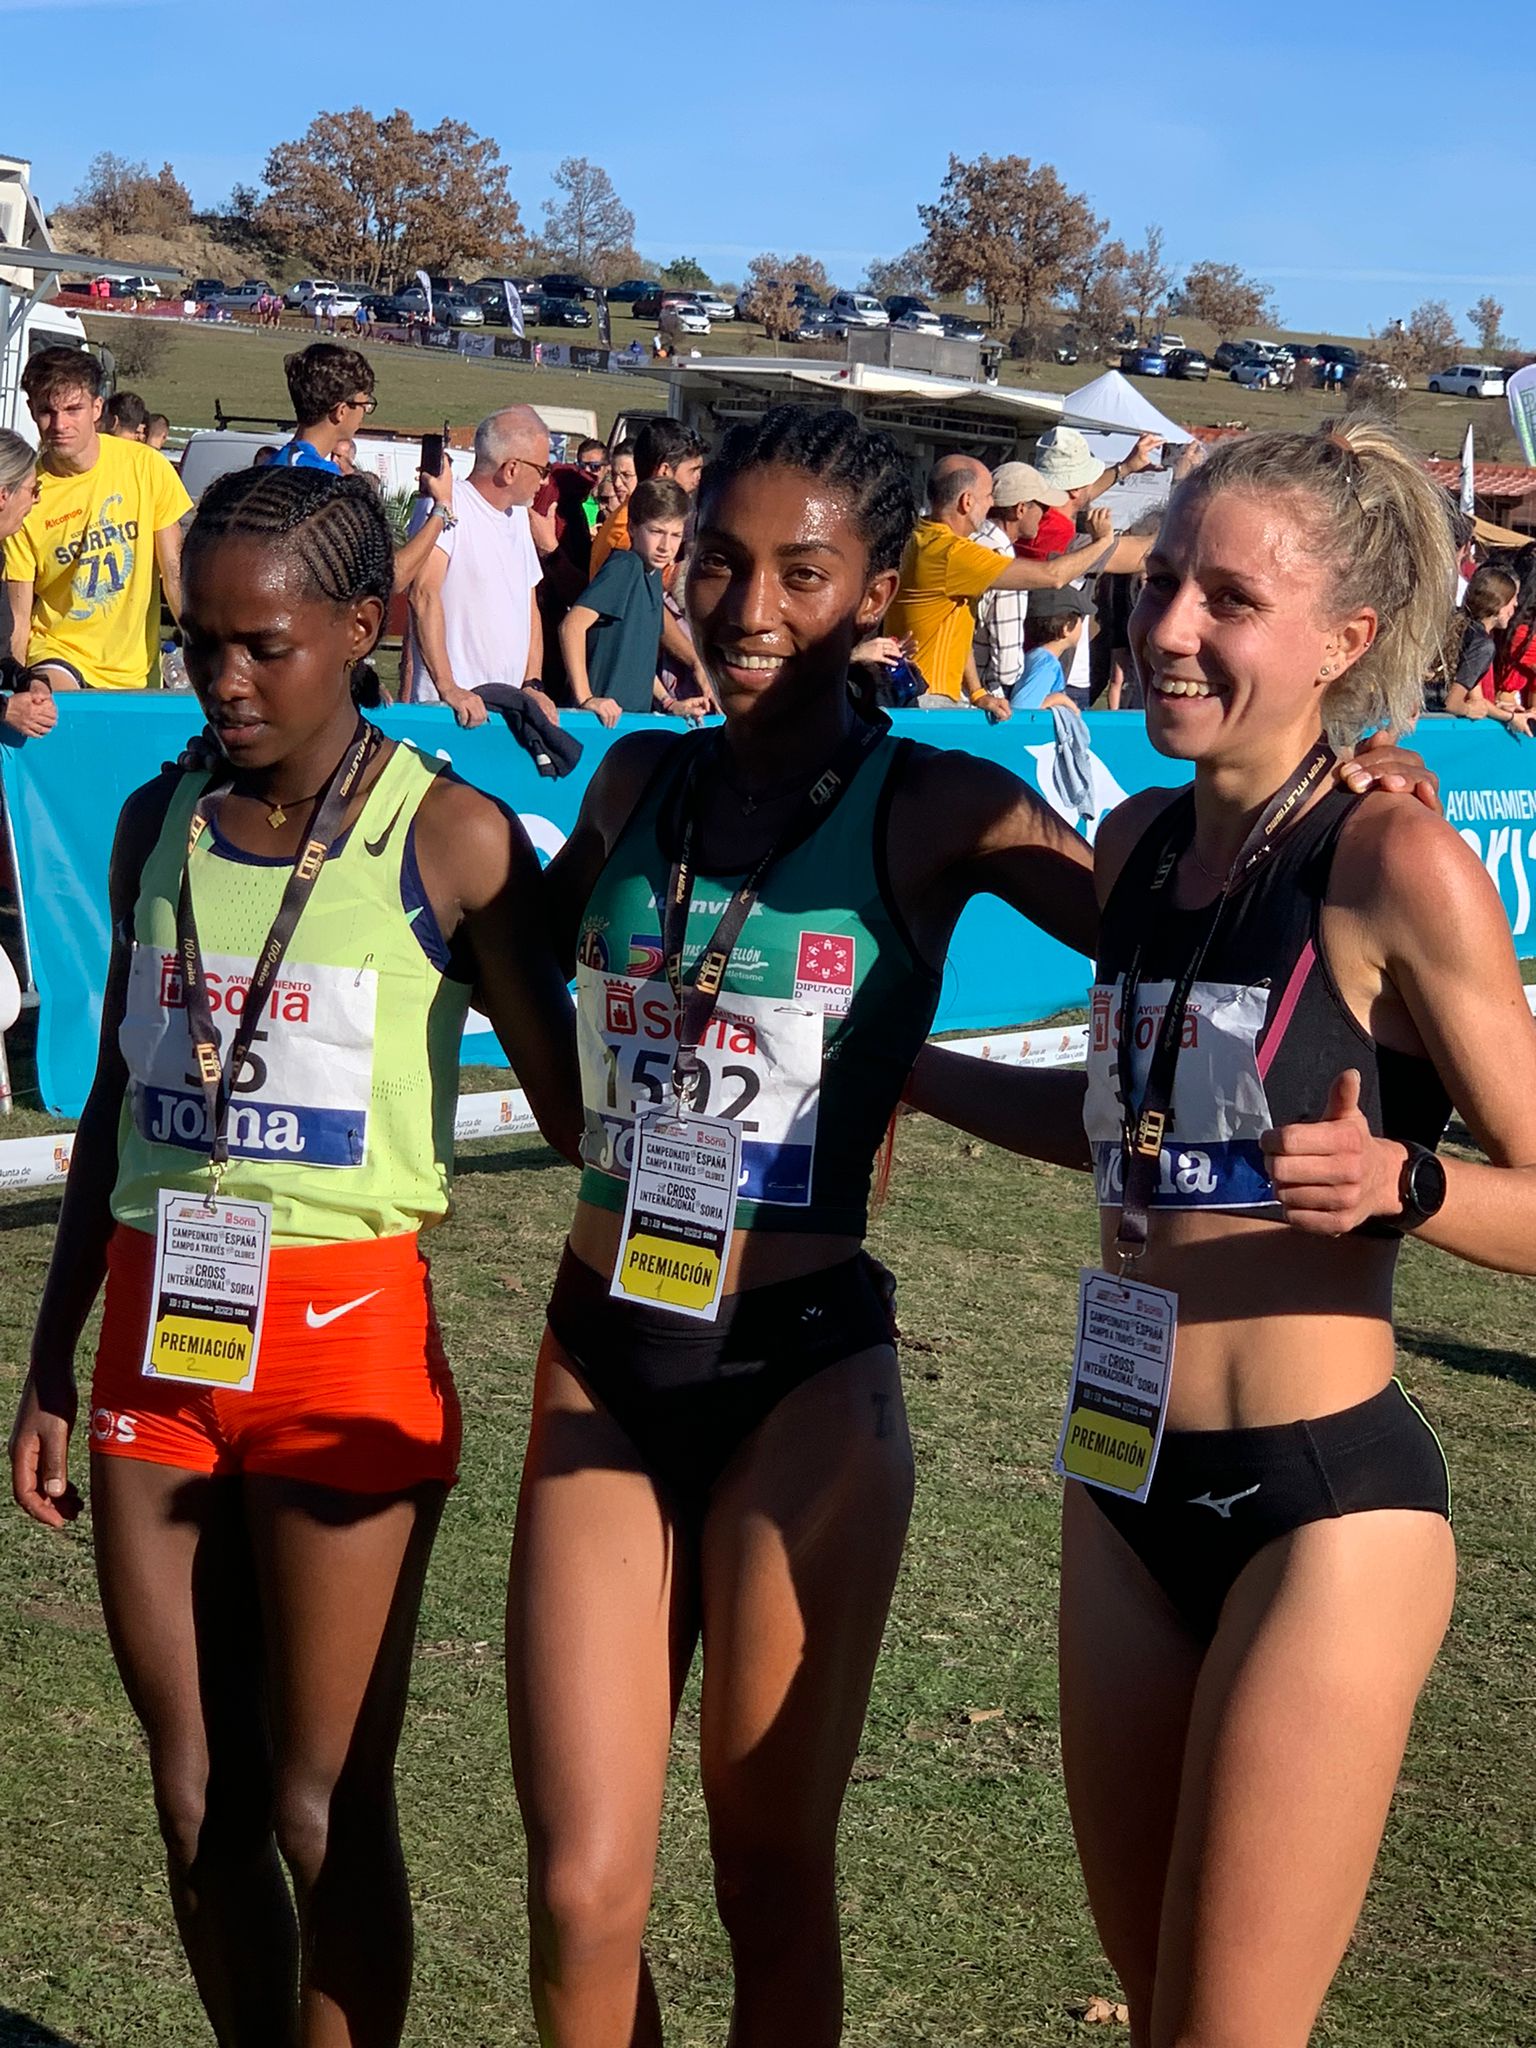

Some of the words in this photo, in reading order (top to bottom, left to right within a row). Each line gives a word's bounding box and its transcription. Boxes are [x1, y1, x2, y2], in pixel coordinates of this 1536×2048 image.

[78, 551, 125, 598] 71
[1265, 777, 1309, 835] ATLETISMO
[203, 972, 310, 1023] Soia
[795, 982, 852, 995] DIPUTACIÓ
[645, 1156, 668, 1170] CAMPO
[673, 1162, 697, 1176] TRAVÉS
[646, 1143, 690, 1162] CAMPEONATO
[696, 1152, 727, 1170] ESPAÑA
[639, 1190, 696, 1214] INTERNACIONAL
[700, 1204, 723, 1220] SORIA
[667, 1182, 697, 1201] CROSS
[171, 1239, 195, 1252] CAMPO
[201, 1243, 225, 1256] TRAVÉS
[172, 1227, 219, 1243] CAMPEONATO
[225, 1232, 257, 1248] ESPAÑA
[195, 1264, 226, 1280] CROSS
[628, 1250, 713, 1288] PREMIACIÓN
[167, 1273, 225, 1292] INTERNACIONAL
[230, 1282, 255, 1297] SORIA
[160, 1331, 246, 1361] PREMIACIÓN
[1108, 1353, 1136, 1374] CROSS
[1083, 1360, 1134, 1388] INTERNACIONAL
[1137, 1377, 1159, 1396] SORIA
[1070, 1424, 1147, 1469] PREMIACIÓN
